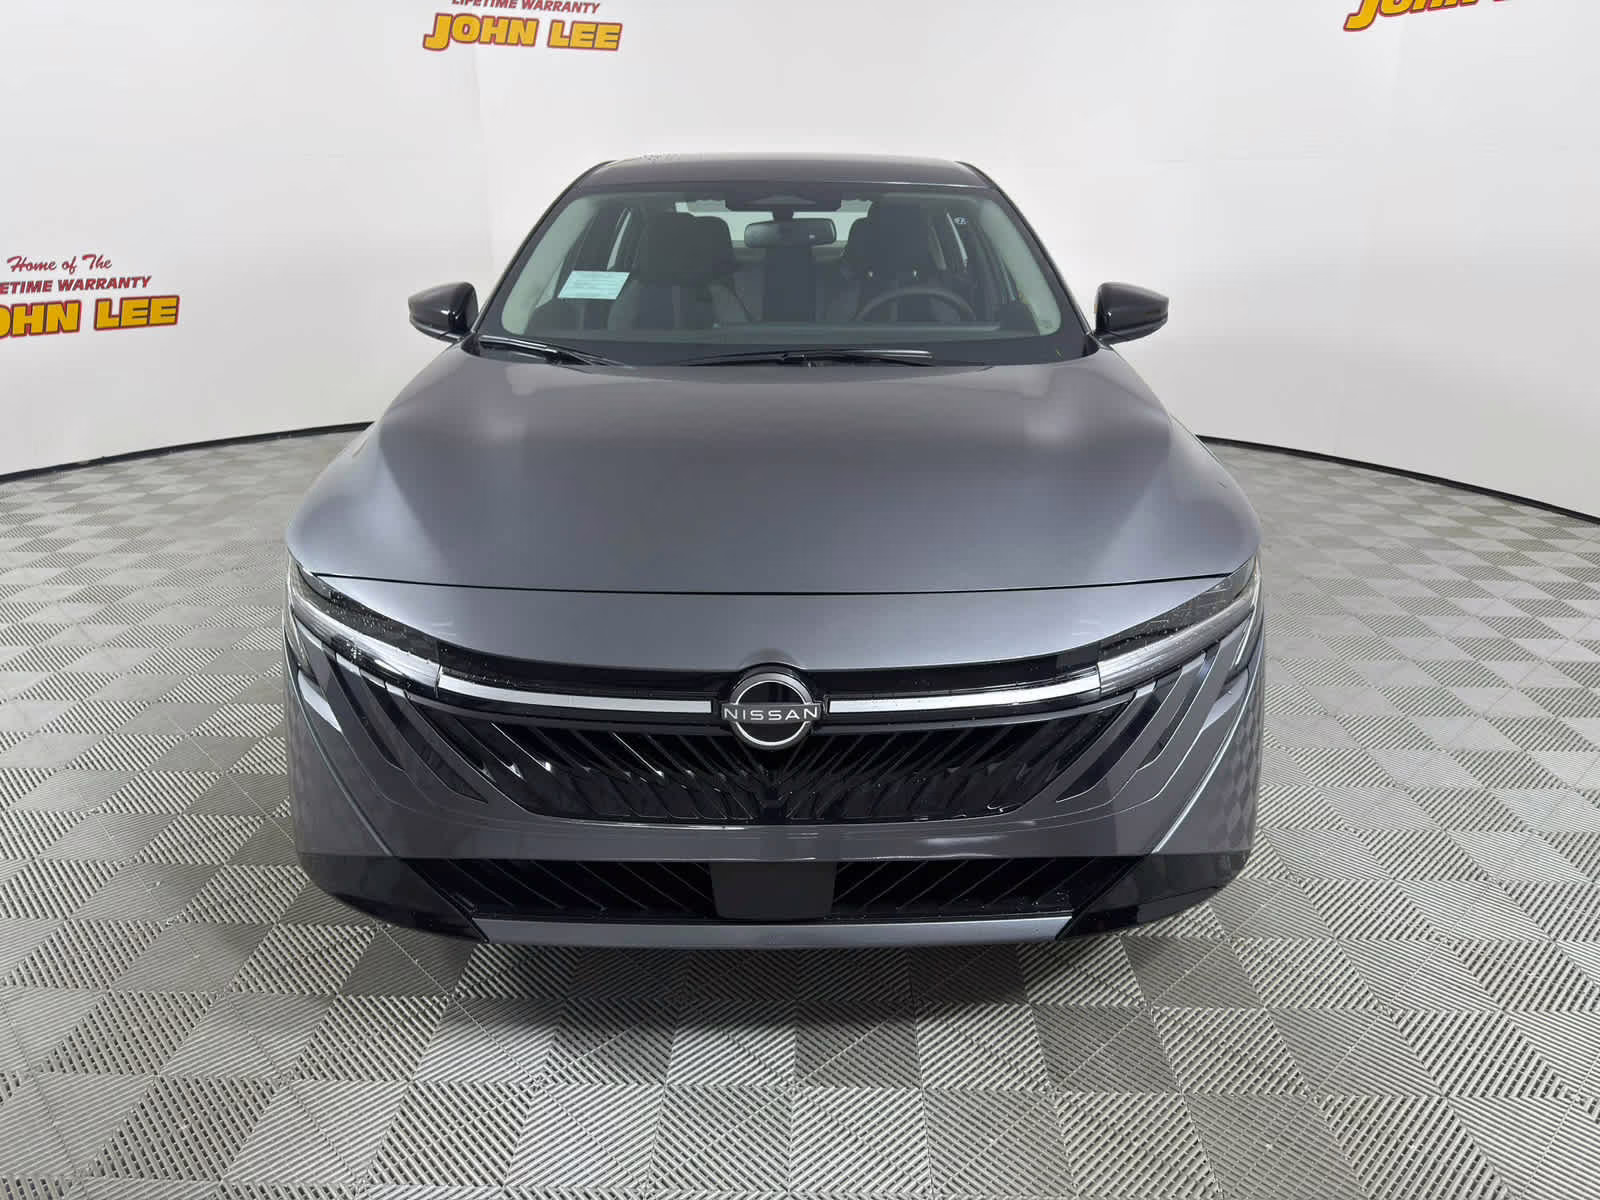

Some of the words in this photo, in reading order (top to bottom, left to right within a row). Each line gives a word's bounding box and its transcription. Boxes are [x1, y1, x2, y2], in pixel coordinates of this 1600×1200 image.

[521, 0, 600, 14] WARRANTY
[423, 13, 539, 51] JOHN
[547, 19, 623, 51] LEE
[7, 255, 57, 272] Home
[61, 256, 77, 275] of
[82, 253, 112, 270] The
[57, 275, 152, 292] WARRANTY
[94, 295, 180, 331] LEE
[723, 706, 818, 721] NISSAN
